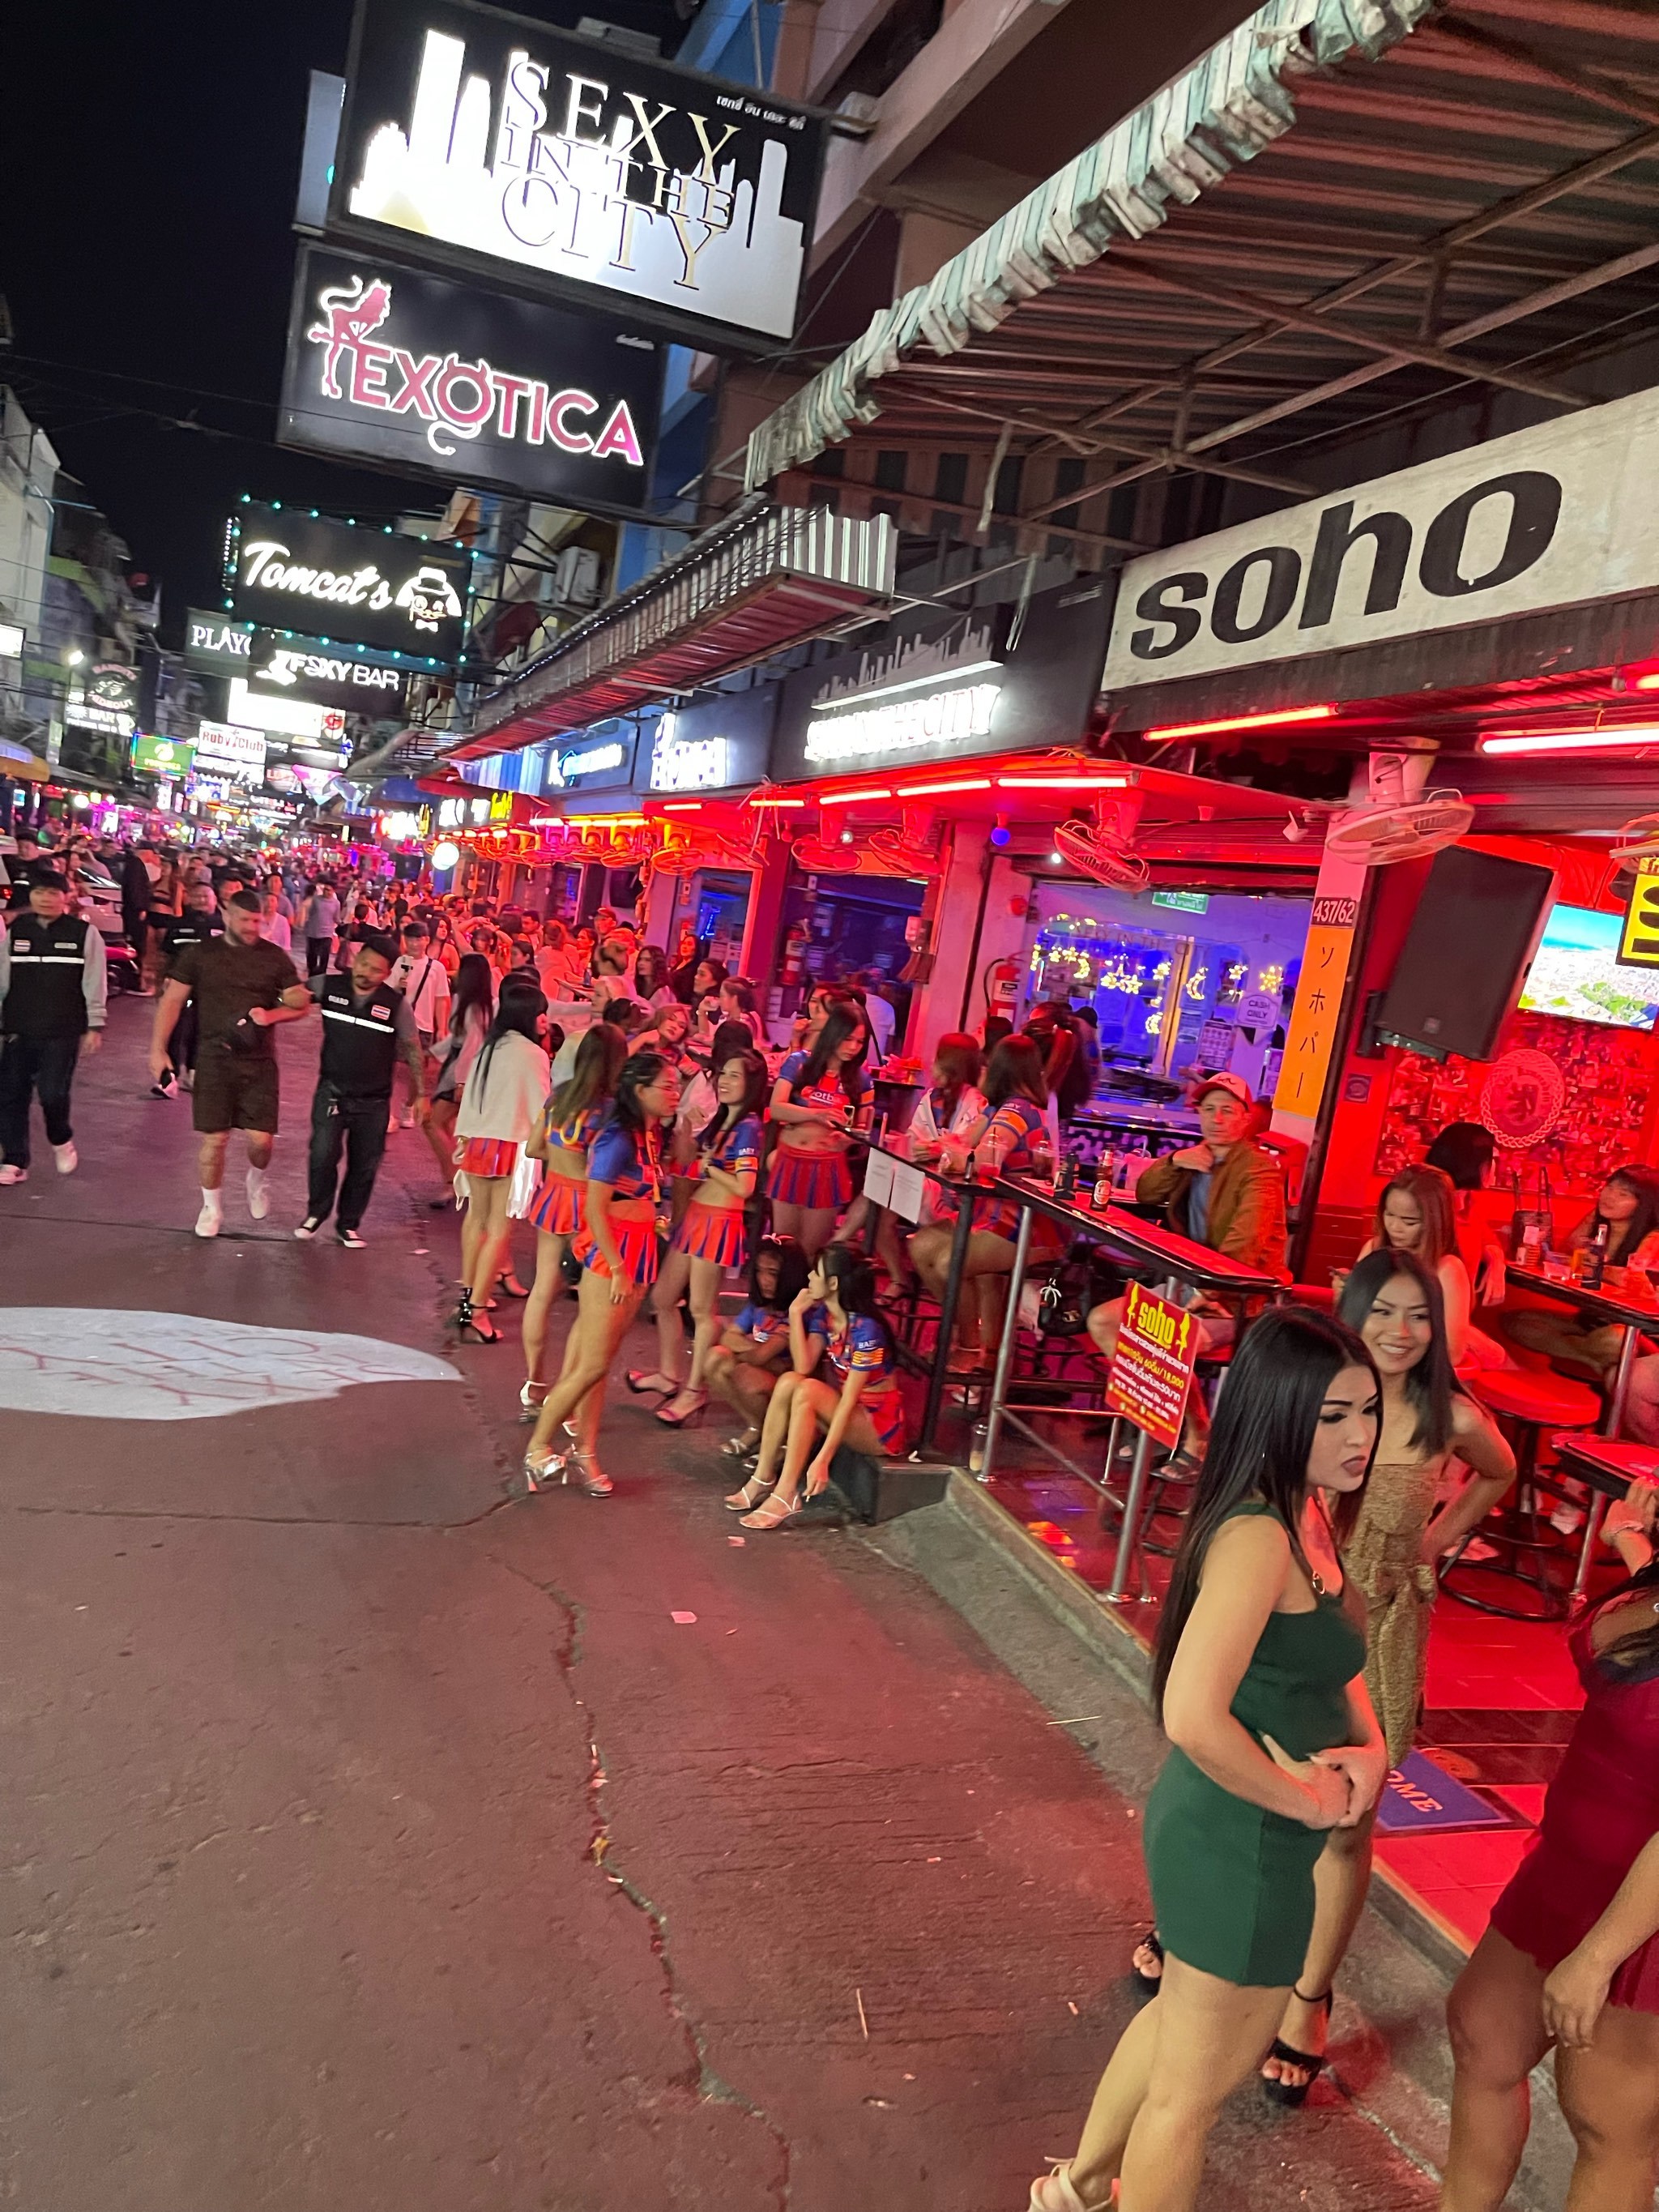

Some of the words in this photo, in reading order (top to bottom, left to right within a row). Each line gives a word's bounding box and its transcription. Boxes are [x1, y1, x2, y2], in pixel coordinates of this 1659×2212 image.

[511, 61, 742, 185] SEXY
[501, 126, 580, 181] IN
[605, 154, 736, 230] THE
[501, 176, 728, 291] CITY
[350, 344, 645, 467] EXOTICA
[245, 541, 393, 610] Tomcat's
[1130, 470, 1563, 660] soho
[190, 625, 253, 655] PLAY
[352, 664, 400, 691] BAR
[237, 736, 264, 753] Club
[1312, 899, 1355, 925] 437/62
[1137, 1300, 1175, 1345] soho
